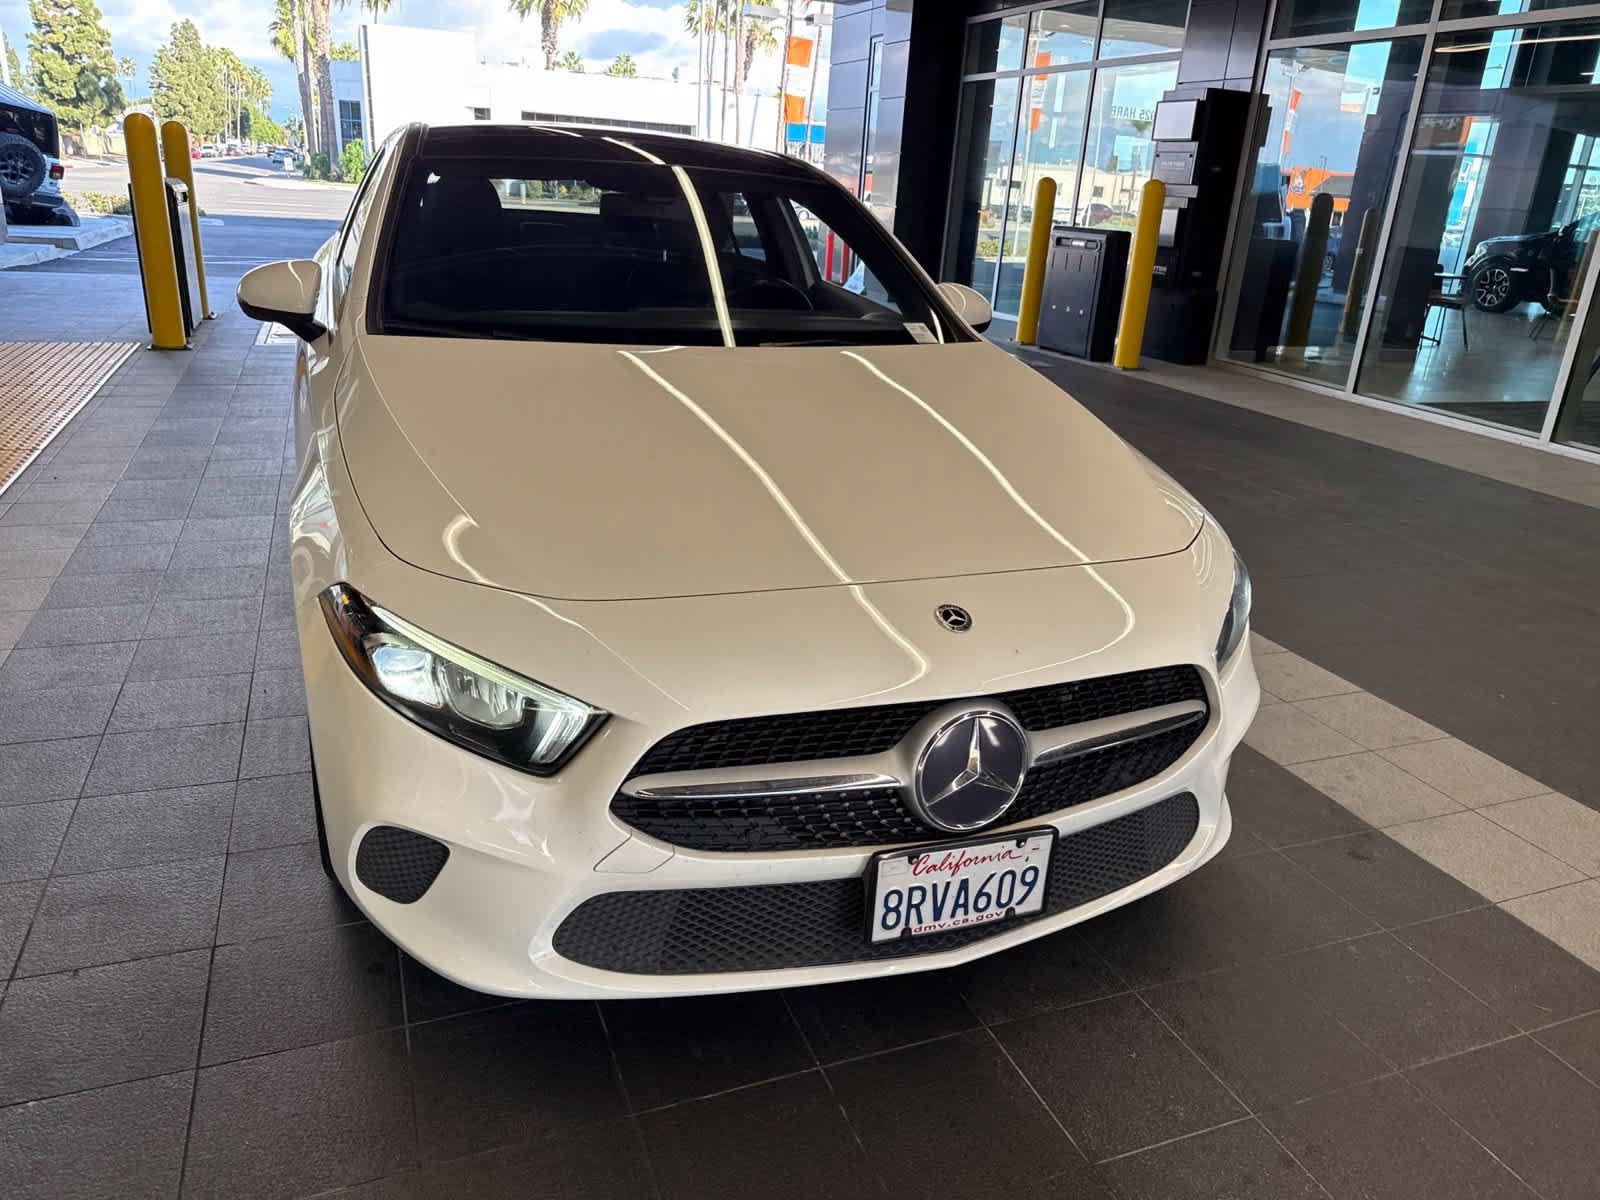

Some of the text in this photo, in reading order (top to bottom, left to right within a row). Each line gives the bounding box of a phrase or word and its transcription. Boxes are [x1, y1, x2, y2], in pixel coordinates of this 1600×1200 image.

[912, 849, 1021, 877] California
[881, 865, 1040, 931] 8RVA609
[913, 910, 1004, 933] dmv.ca.gov
